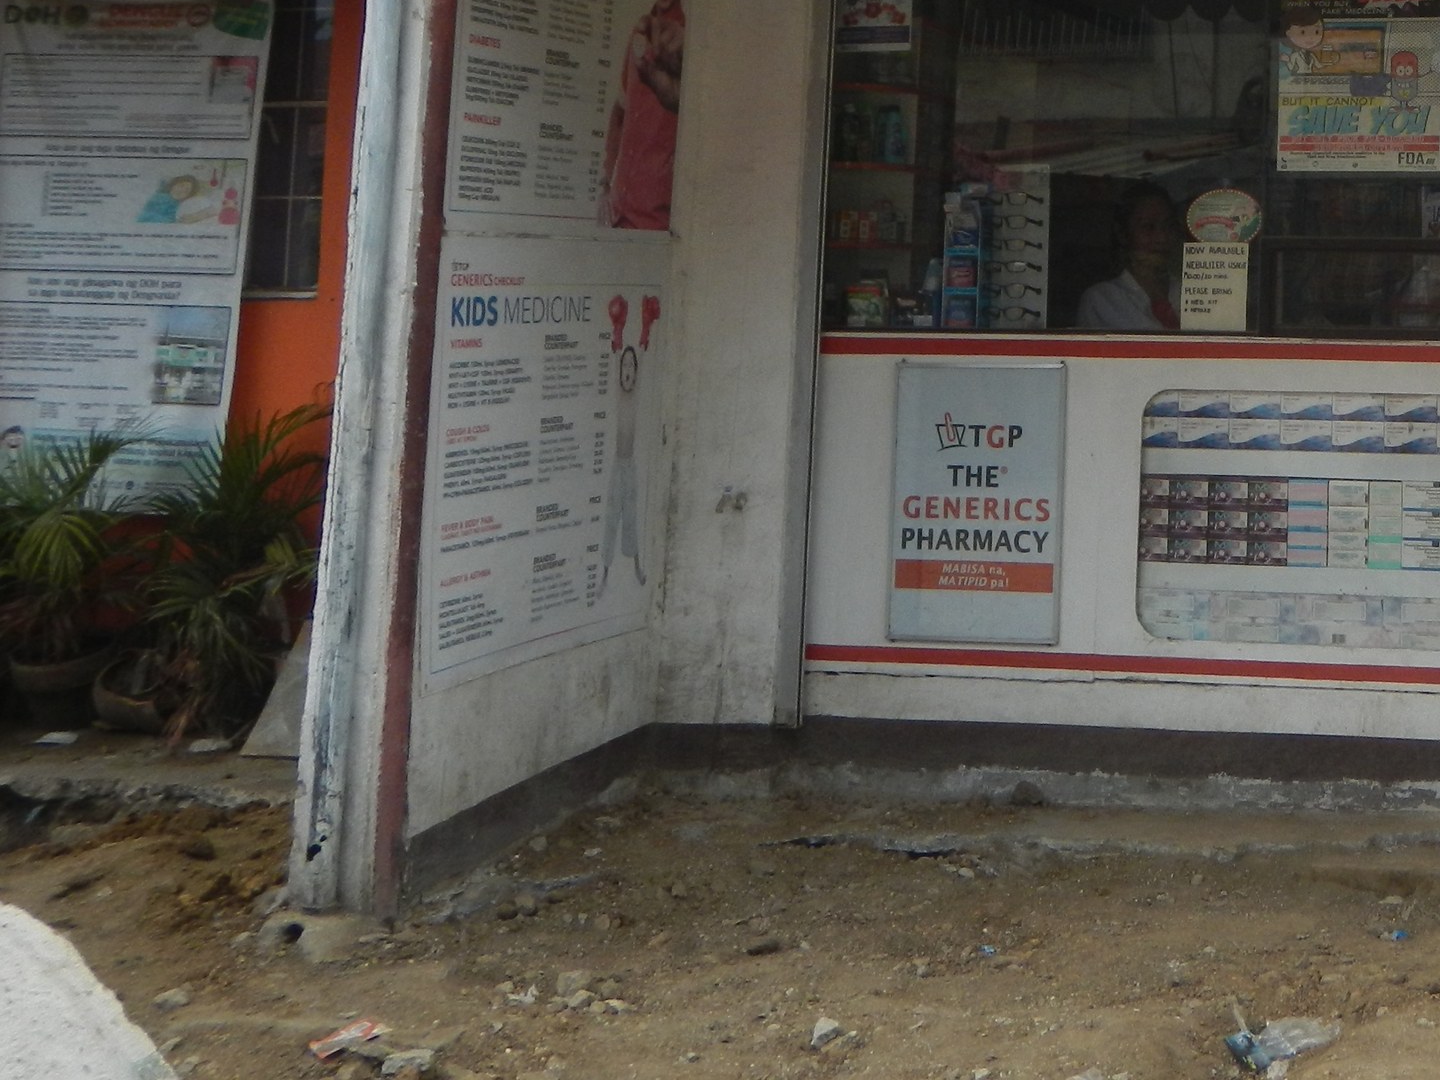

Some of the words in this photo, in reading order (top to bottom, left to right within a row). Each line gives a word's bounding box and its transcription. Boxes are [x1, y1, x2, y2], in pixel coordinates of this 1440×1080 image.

[1282, 97, 1303, 106] BUT
[1310, 97, 1318, 106] IT
[1327, 97, 1374, 106] CANNOT
[1288, 105, 1361, 135] SAVE
[1369, 105, 1431, 136] YOU
[1398, 152, 1425, 165] FDA
[451, 274, 493, 286] GENERICS
[451, 295, 498, 327] KIDS
[504, 296, 591, 324] MEDICINE
[968, 425, 1023, 448] TGP
[947, 465, 999, 487] THE
[903, 495, 1050, 522] GENERICS
[901, 528, 1049, 553] PHARMACY
[942, 564, 985, 574] MABISA
[989, 565, 1006, 576] na,
[938, 575, 987, 586] MATIPID
[991, 578, 1009, 588] pa!
